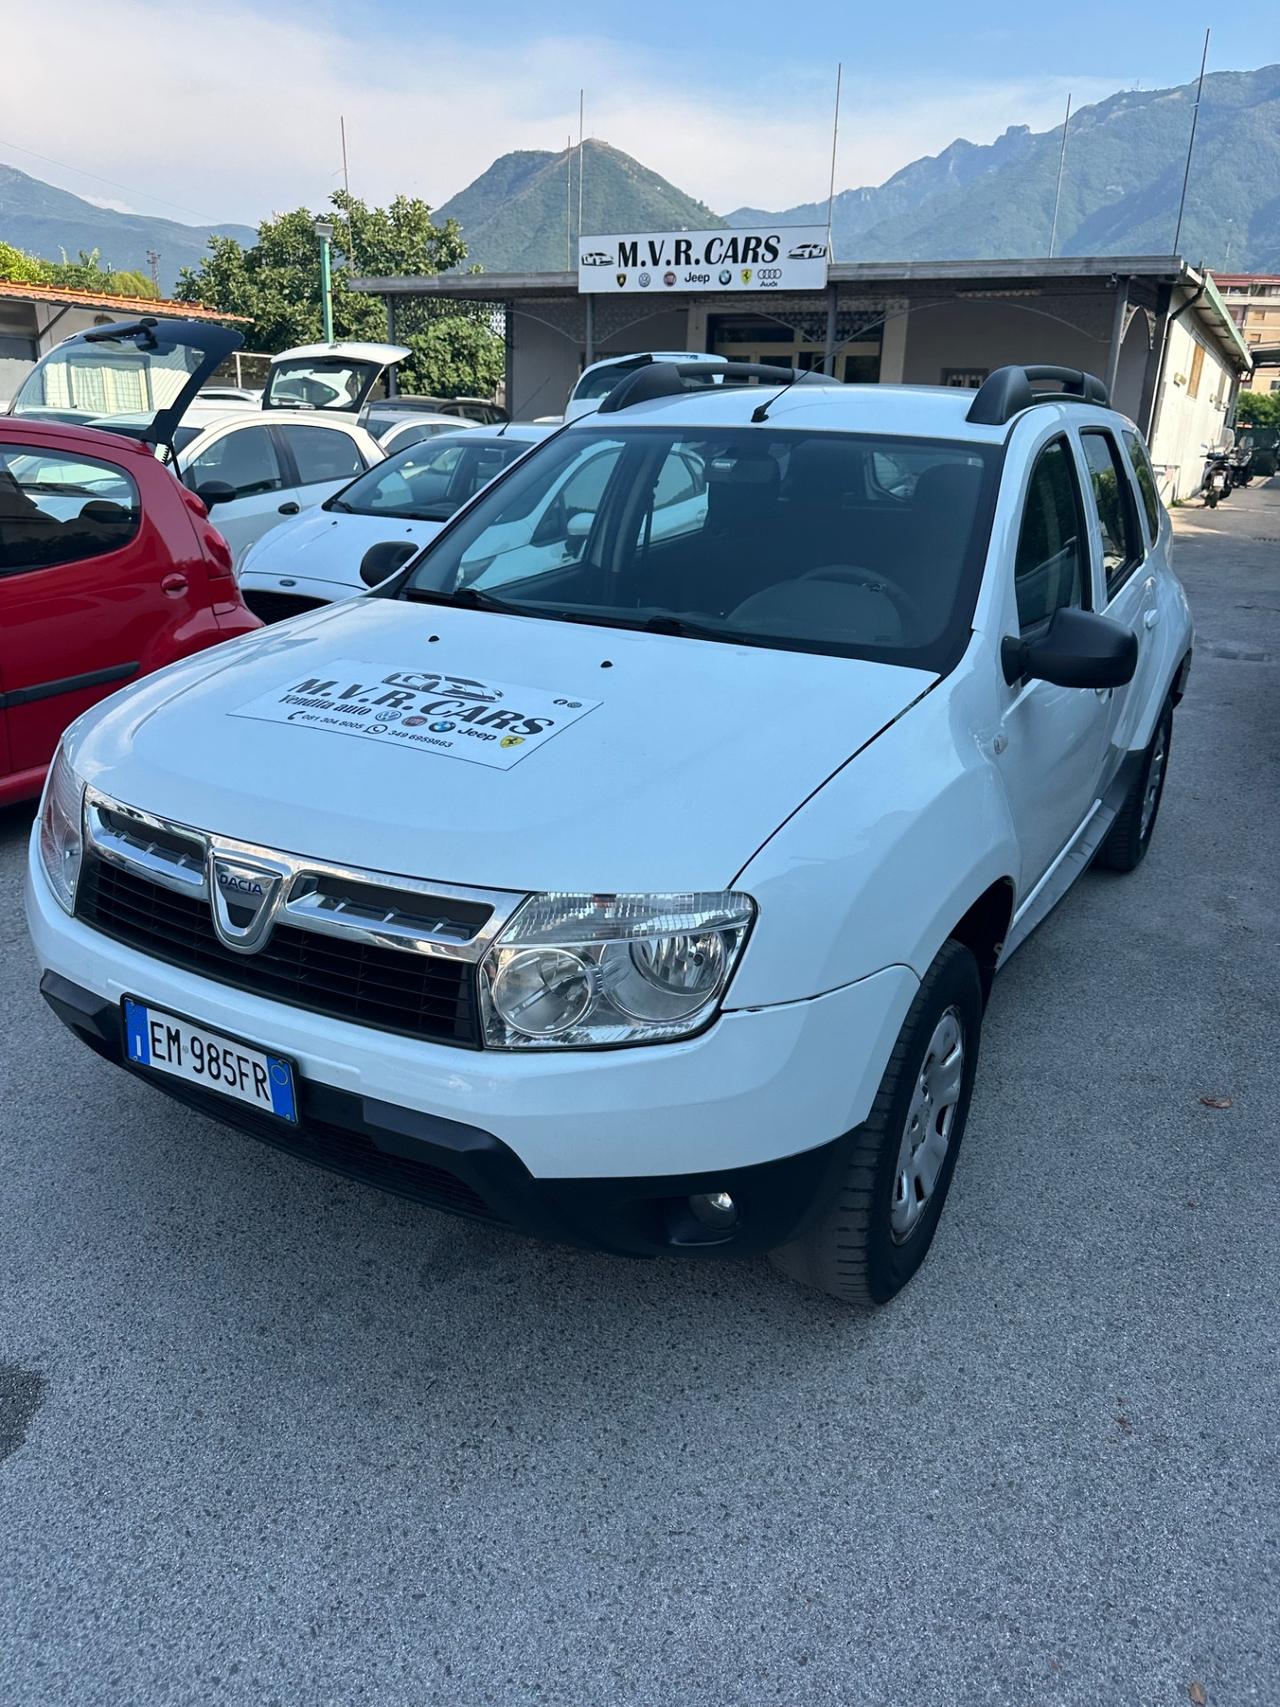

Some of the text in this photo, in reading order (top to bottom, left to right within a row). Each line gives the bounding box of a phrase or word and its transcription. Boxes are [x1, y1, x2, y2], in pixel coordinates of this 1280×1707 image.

[684, 272, 710, 284] Jeep
[278, 694, 372, 716] Vendita auto
[388, 730, 408, 738] 349
[458, 728, 497, 741] Jeep
[219, 874, 263, 895] DACIA
